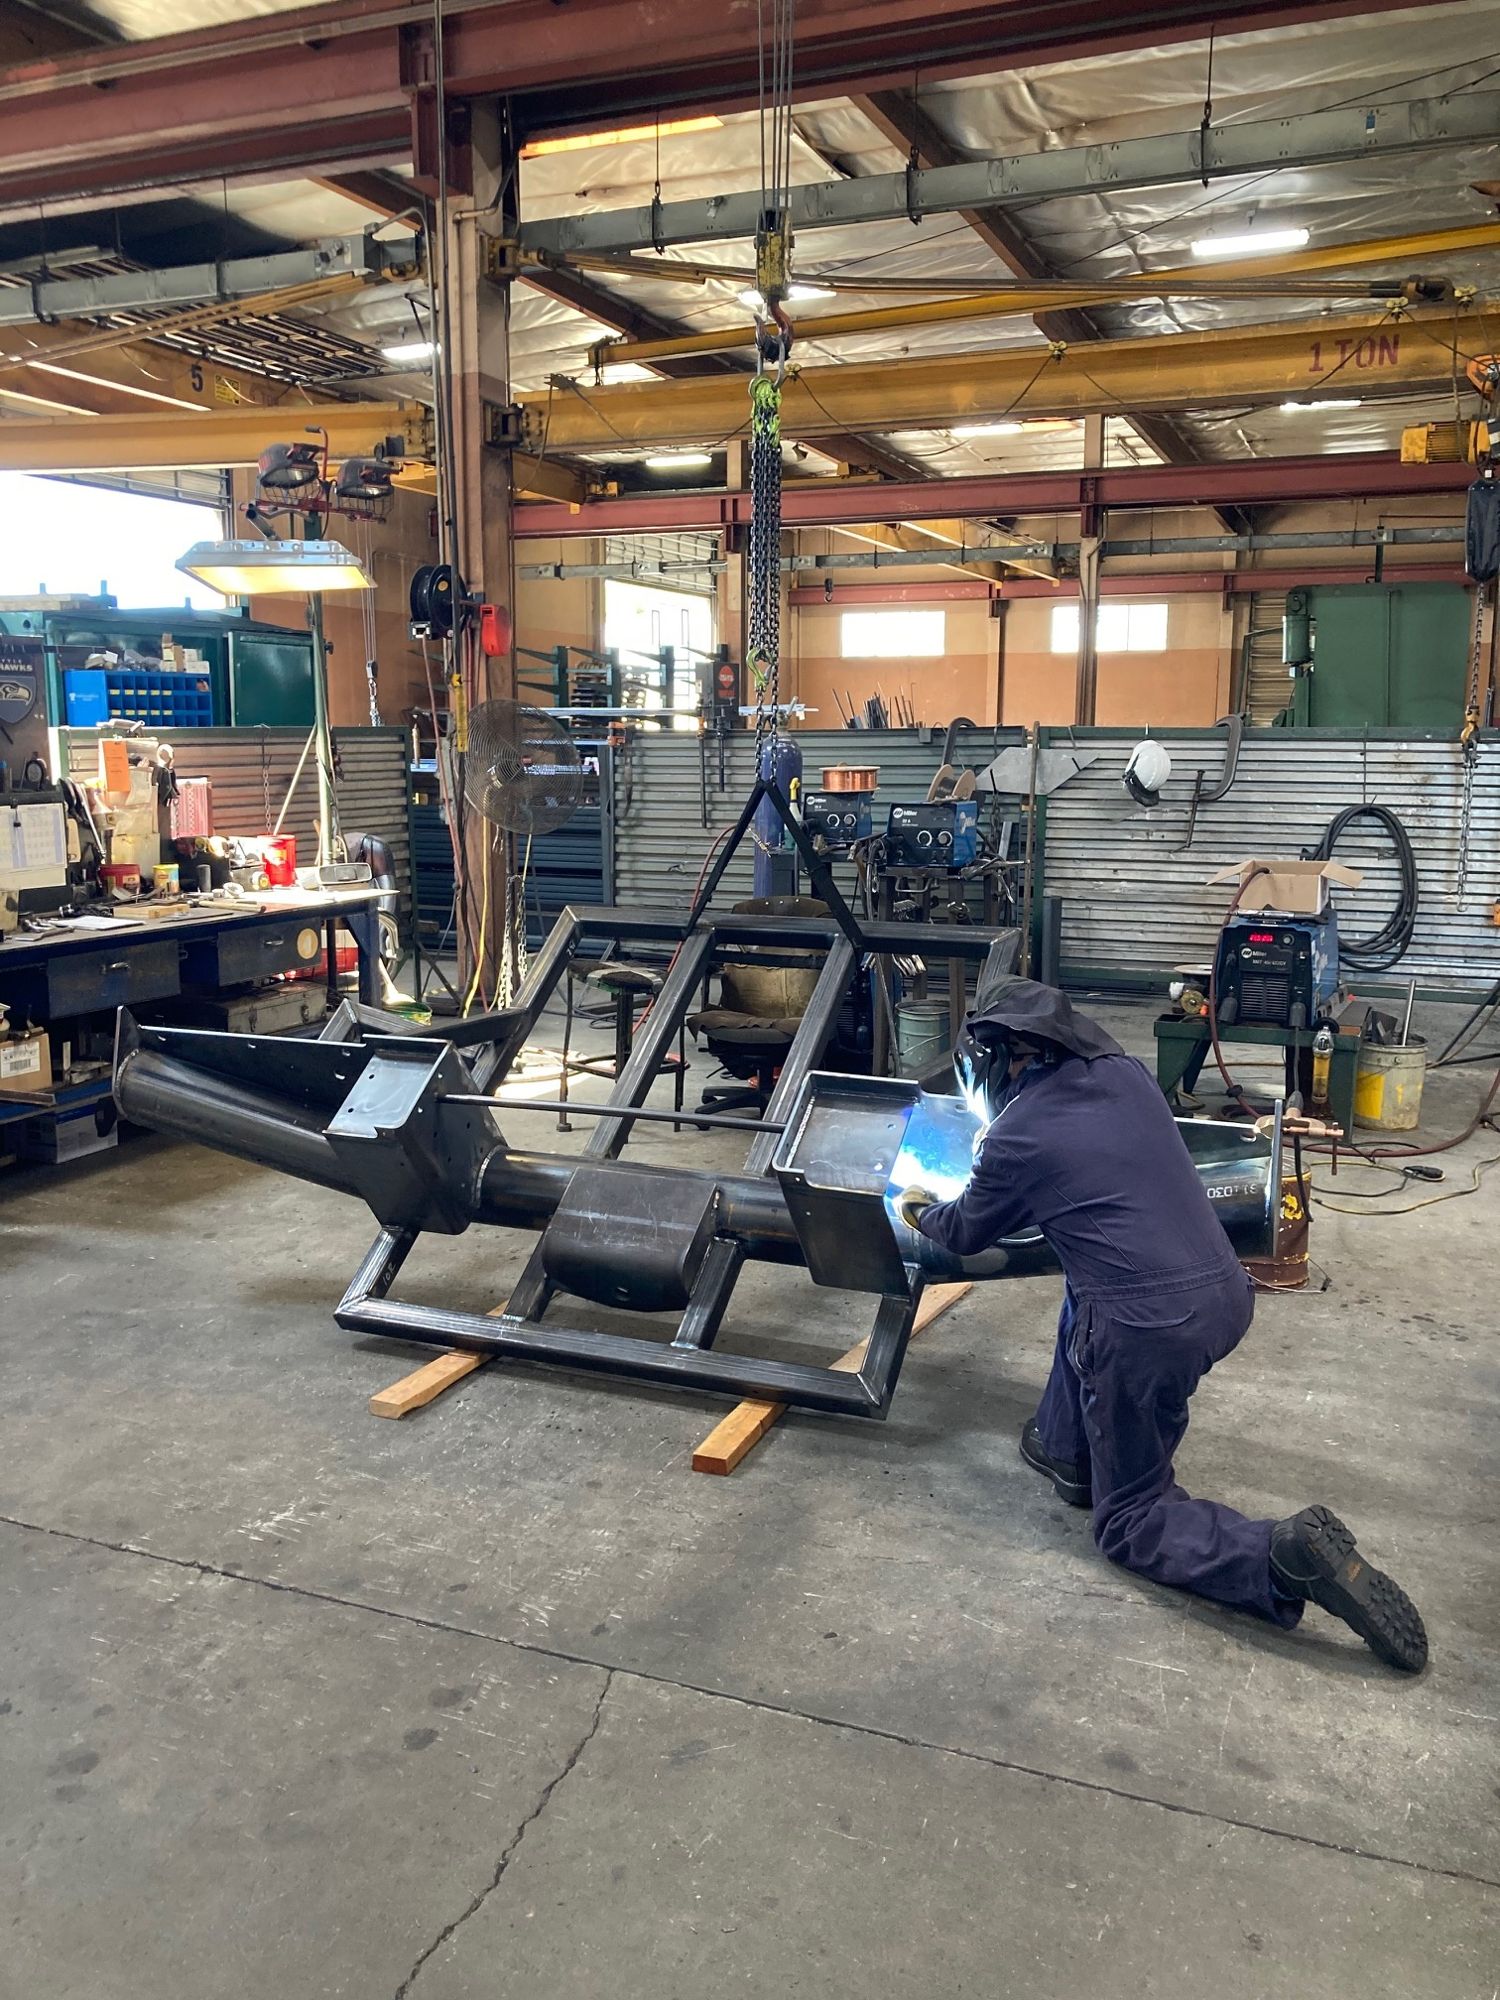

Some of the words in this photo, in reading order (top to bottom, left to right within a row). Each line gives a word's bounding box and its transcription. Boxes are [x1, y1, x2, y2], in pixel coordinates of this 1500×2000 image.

[1309, 342, 1323, 372] 1
[1334, 334, 1400, 369] TON
[191, 364, 203, 392] 5
